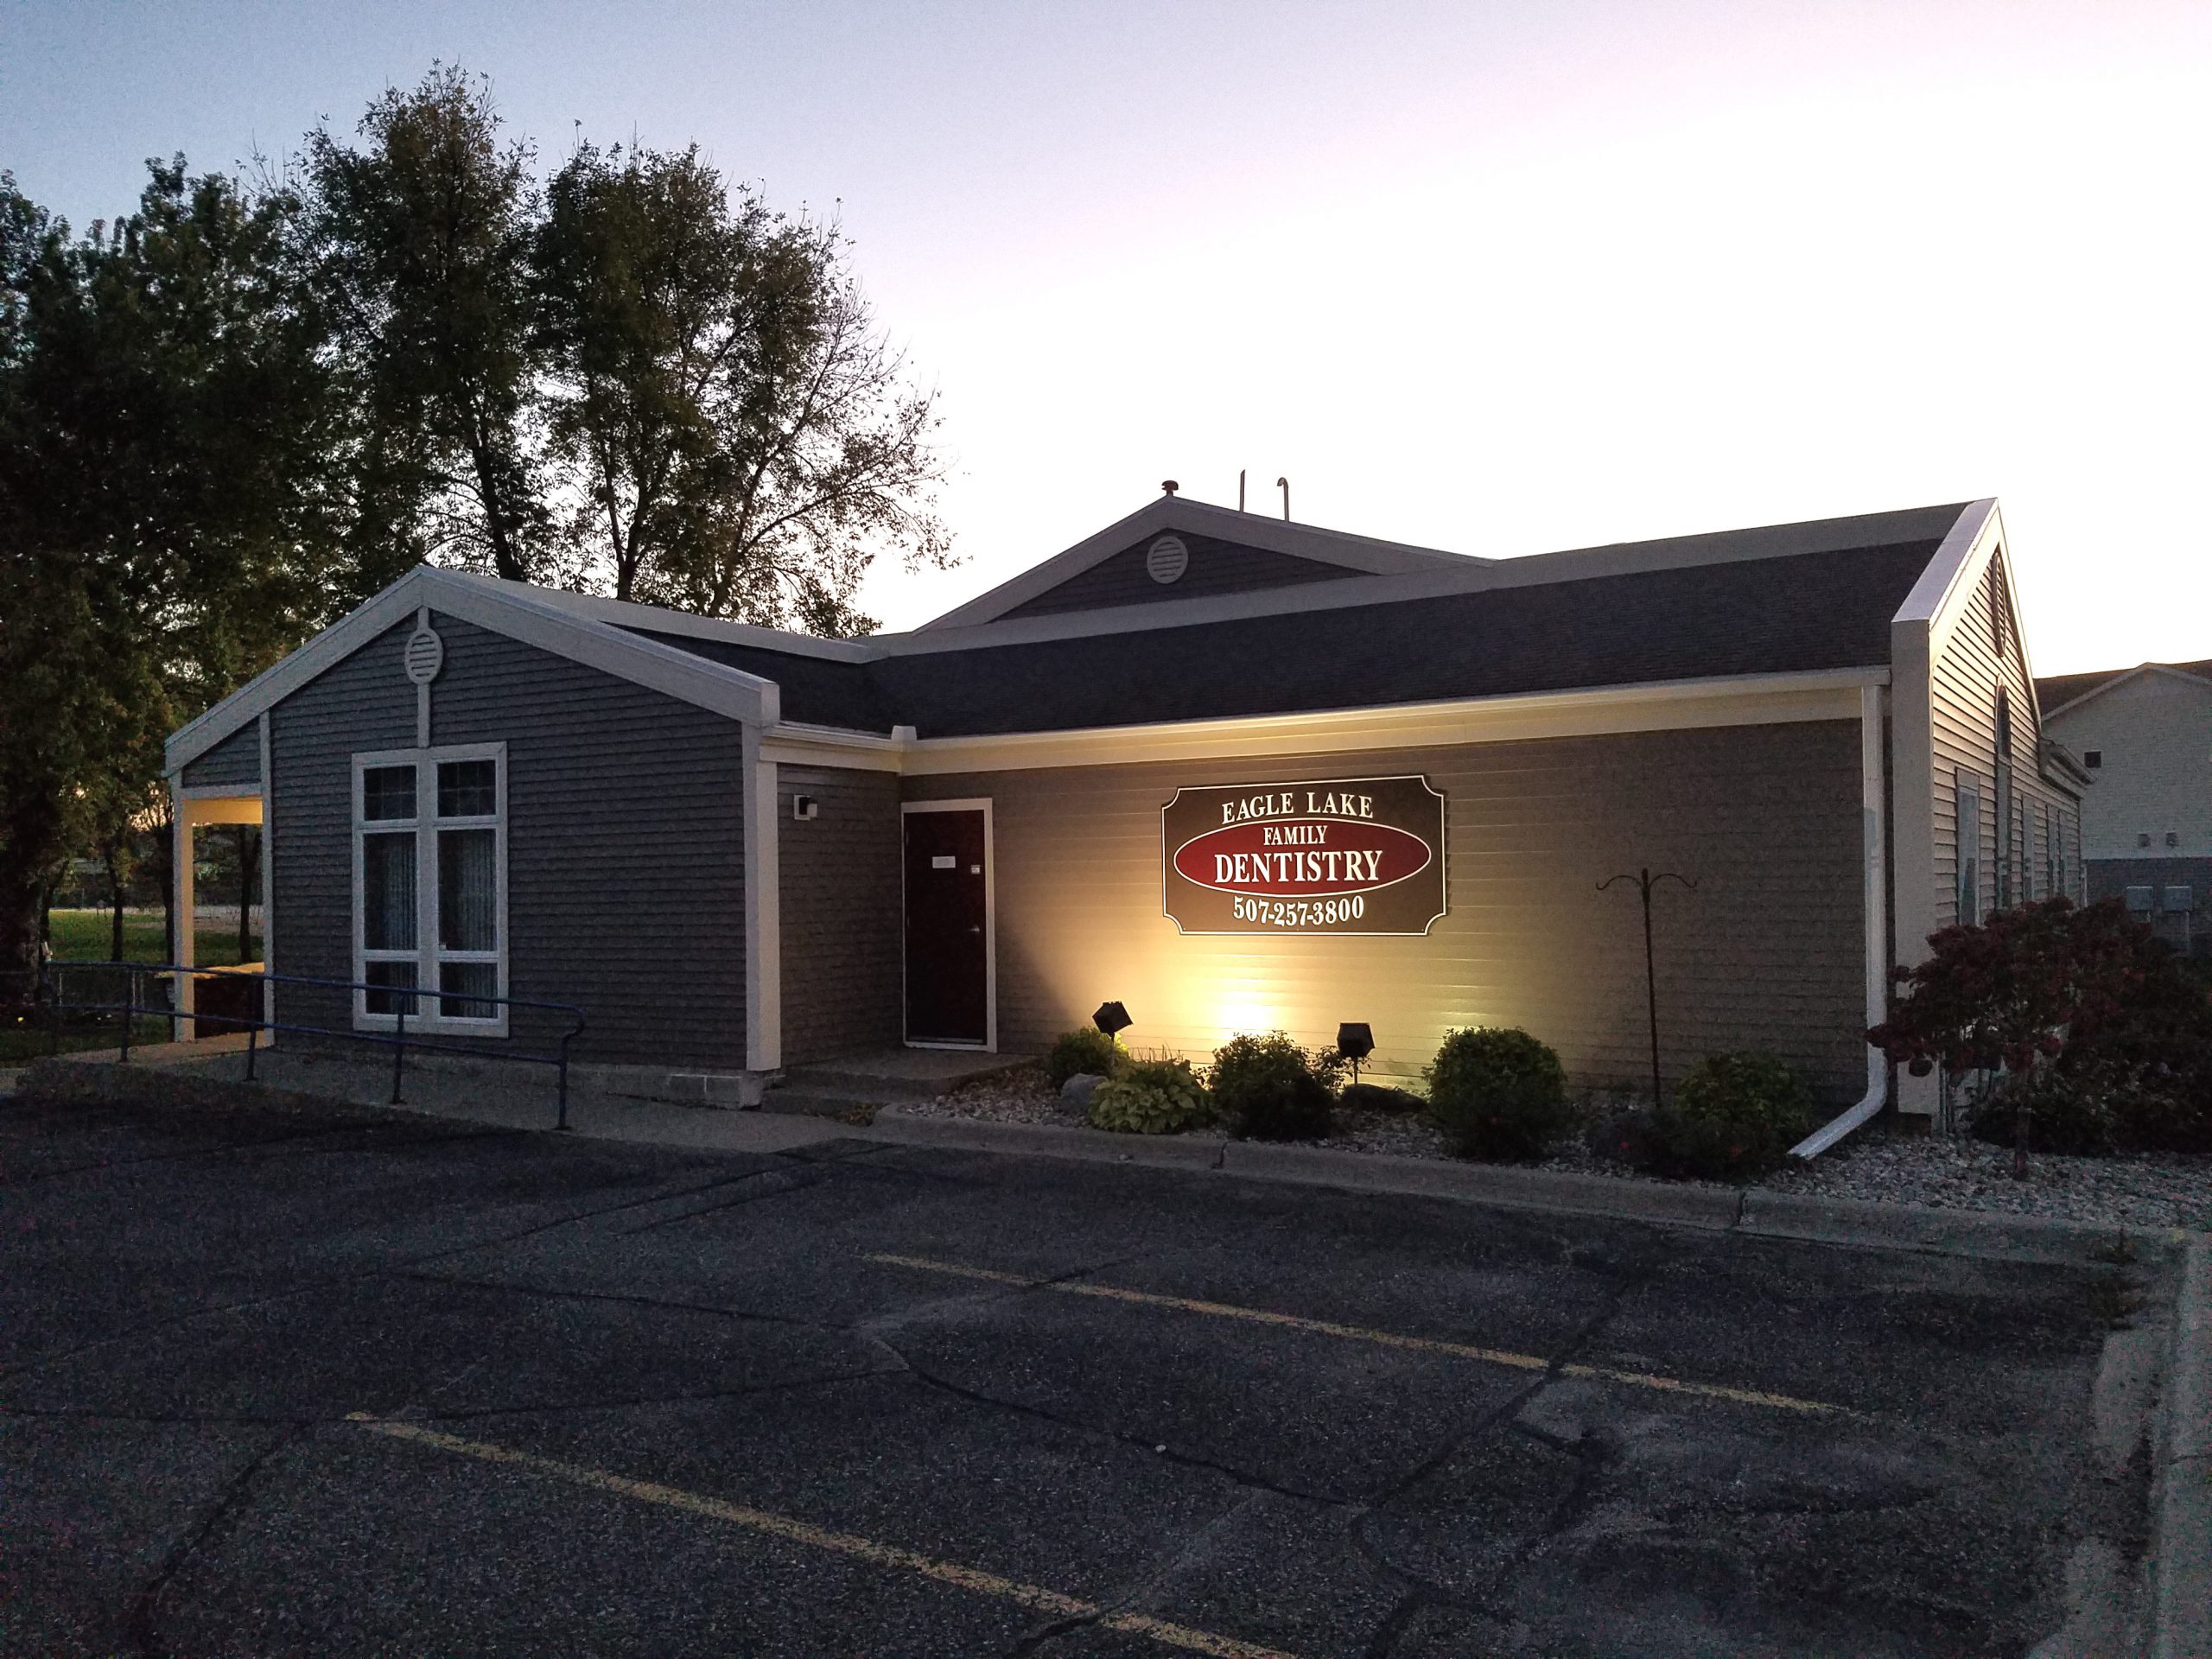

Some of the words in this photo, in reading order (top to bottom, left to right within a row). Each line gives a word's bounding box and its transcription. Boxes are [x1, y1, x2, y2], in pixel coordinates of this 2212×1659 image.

[1222, 792, 1294, 824] EAGLE
[1306, 791, 1374, 819] LAKE
[1263, 825, 1327, 846] FAMILY
[1214, 850, 1382, 883] DENTISTRY
[1233, 895, 1364, 927] 507-257-3800
